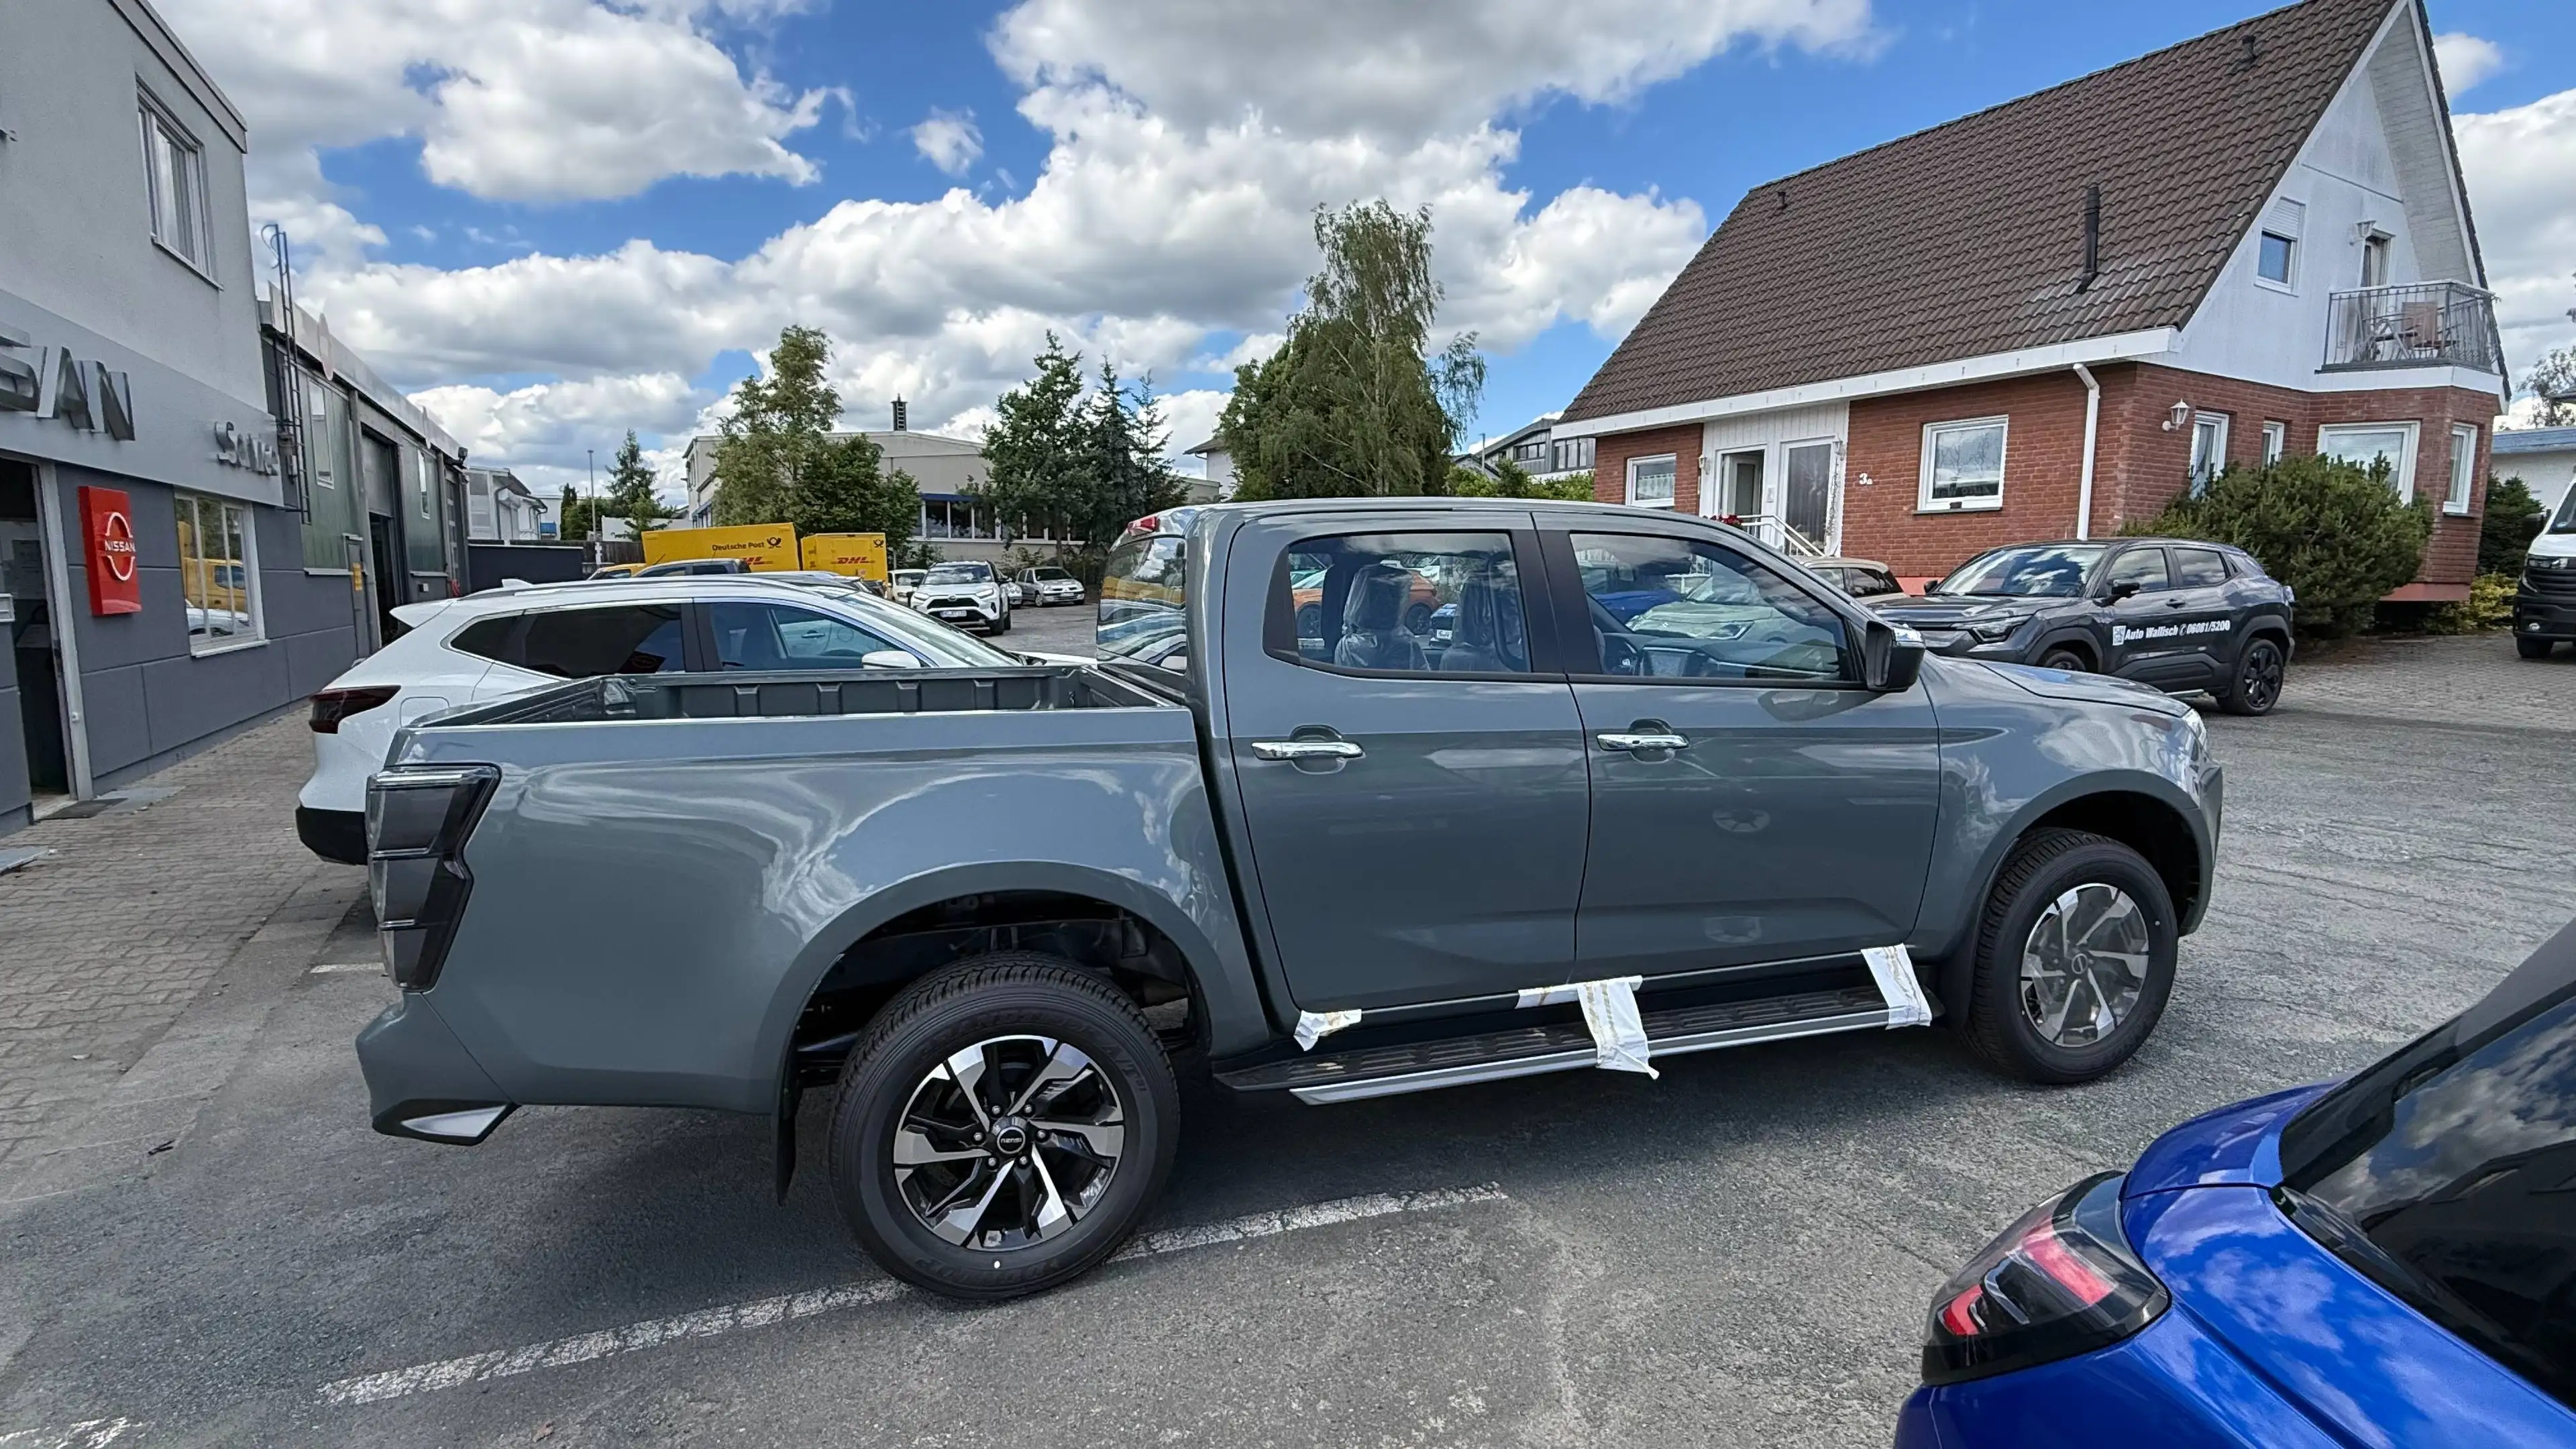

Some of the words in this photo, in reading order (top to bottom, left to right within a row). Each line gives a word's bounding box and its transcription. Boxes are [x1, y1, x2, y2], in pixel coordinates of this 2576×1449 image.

[105, 539, 136, 553] NISSAN
[712, 543, 747, 551] Deutsche
[837, 556, 870, 564] DHL
[2125, 629, 2145, 640] Auto
[2145, 625, 2179, 639] Wallisch
[2186, 620, 2231, 635] 06081/5200
